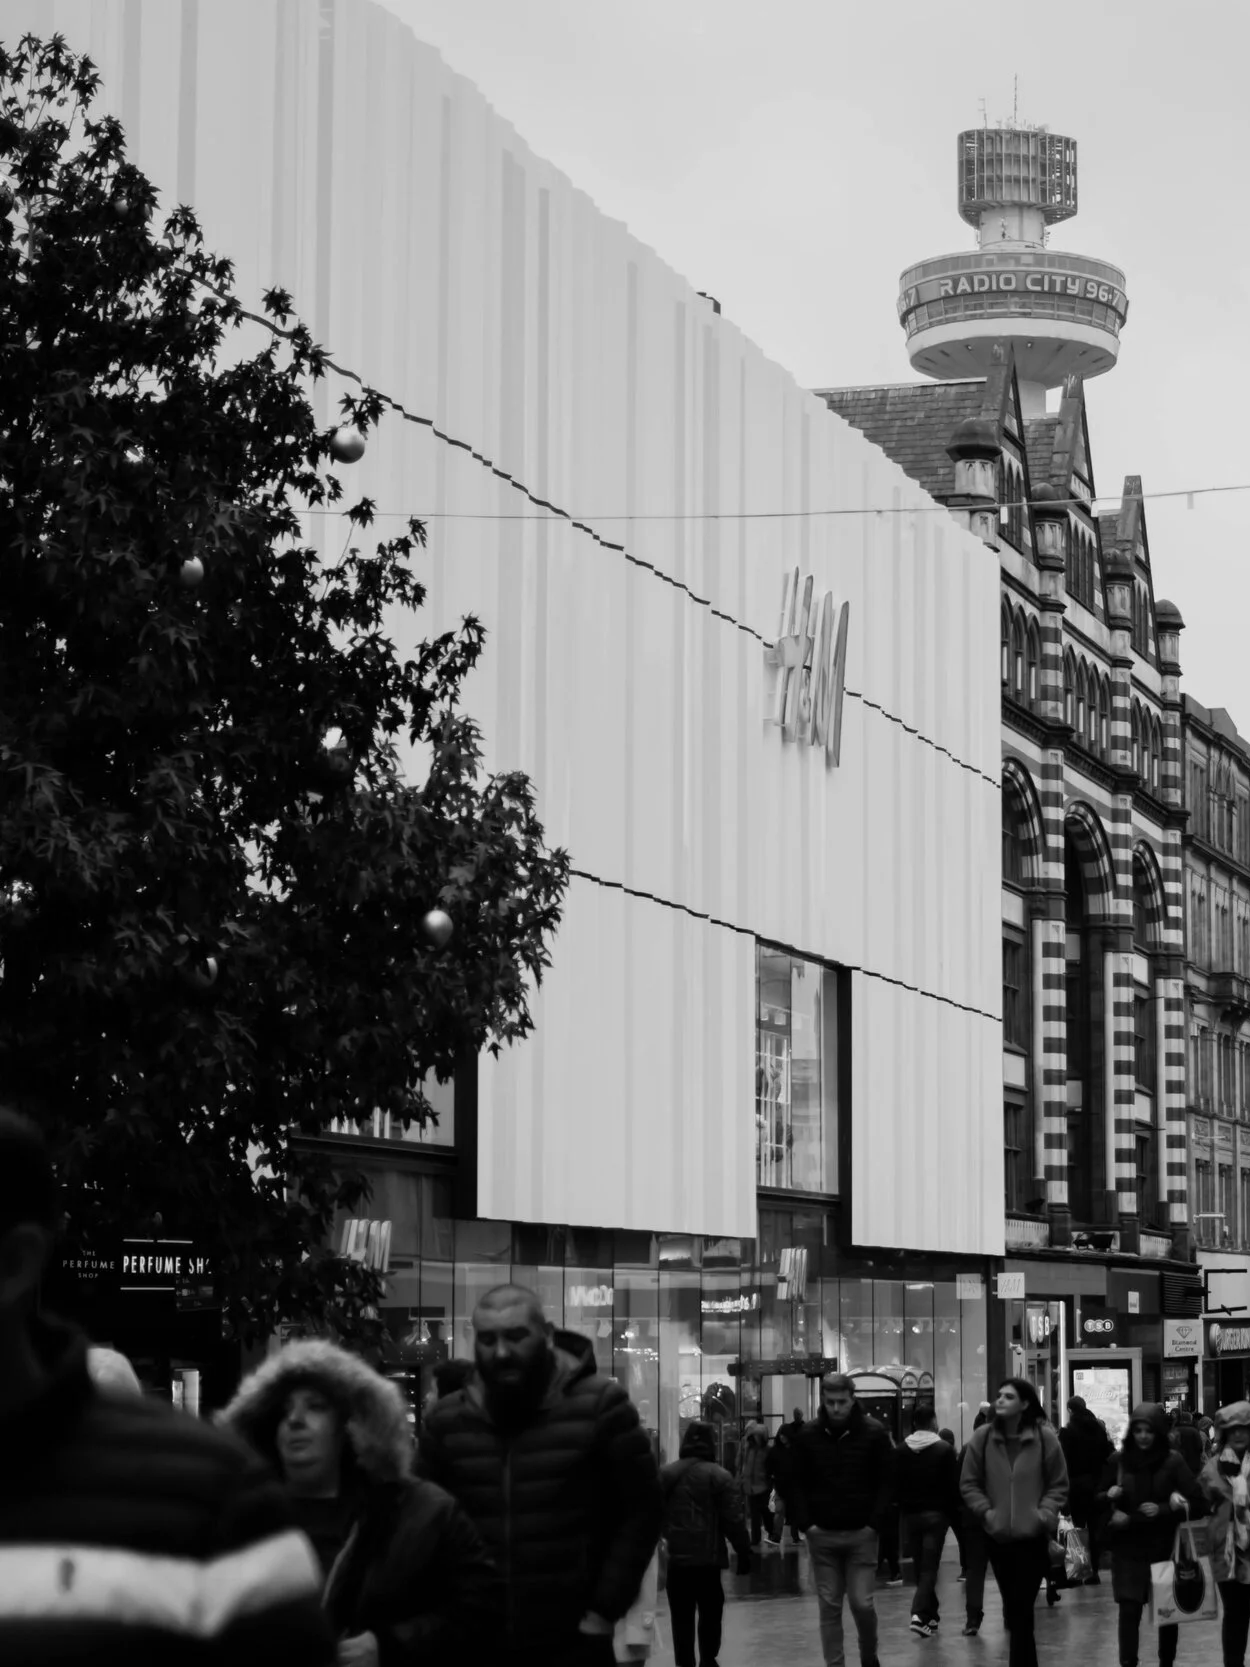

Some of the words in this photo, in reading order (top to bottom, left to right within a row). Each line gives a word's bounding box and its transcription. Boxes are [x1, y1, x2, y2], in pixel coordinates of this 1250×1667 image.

[939, 273, 1016, 296] RADIO
[1025, 273, 1080, 294] CITY
[62, 1259, 115, 1269] PERFUME
[122, 1255, 182, 1274] PERFUME
[1031, 1315, 1050, 1336] TSB
[1085, 1320, 1113, 1332] TSB
